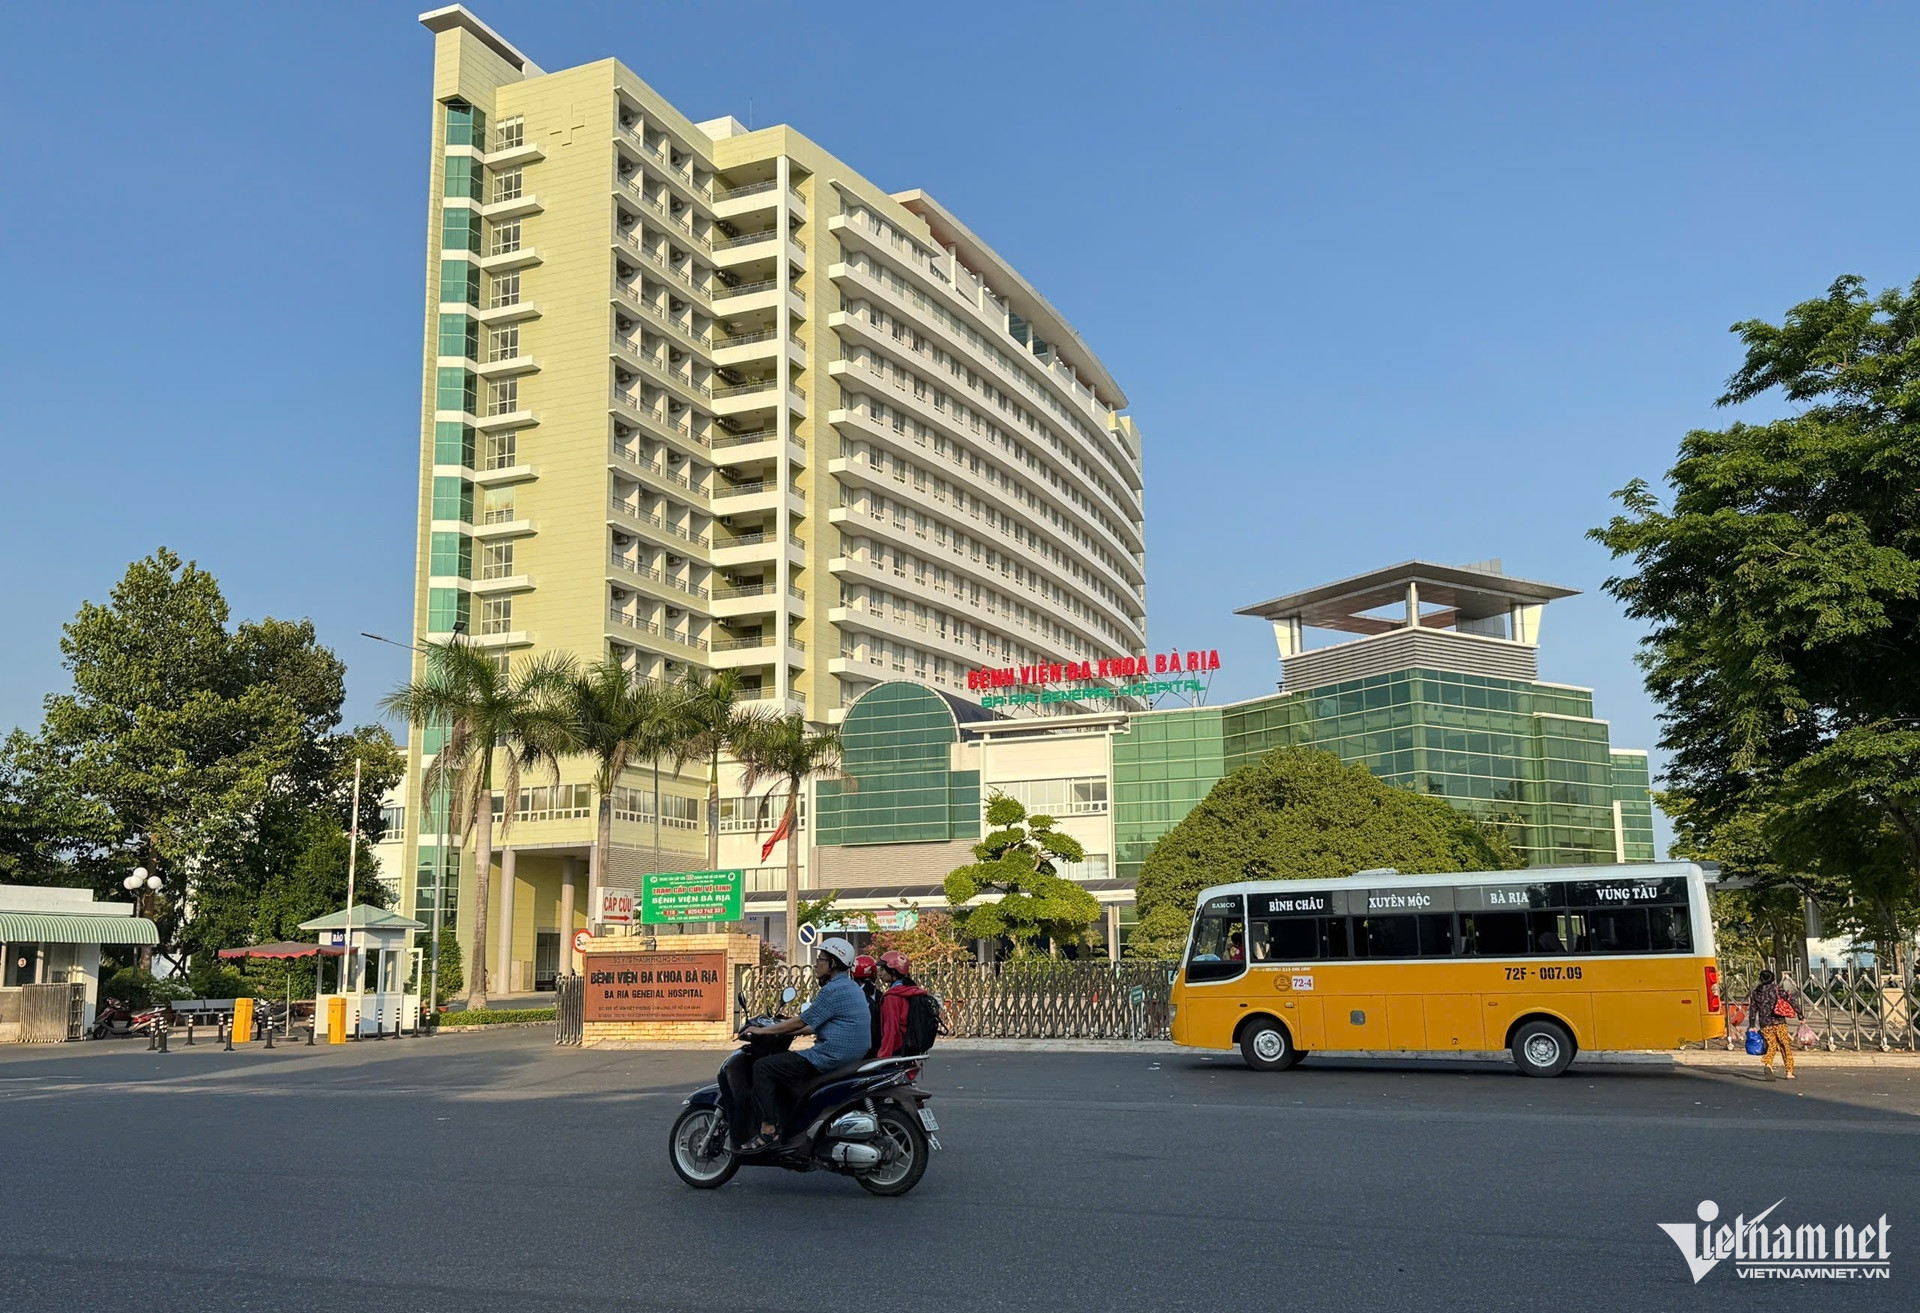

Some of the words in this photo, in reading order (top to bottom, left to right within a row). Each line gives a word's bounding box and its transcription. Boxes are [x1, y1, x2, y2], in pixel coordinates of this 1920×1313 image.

[1020, 658, 1062, 688] VIỆN
[1066, 661, 1092, 681] ĐA
[1098, 655, 1150, 678] KHOA
[1156, 648, 1182, 673] BÀ
[1186, 650, 1220, 674] RỊA
[1040, 687, 1115, 704] GENERAL
[1120, 679, 1206, 696] HOSPITAL
[652, 896, 676, 904] BỆNH
[678, 895, 698, 904] VIỆN
[1490, 890, 1506, 904] BÀ
[1508, 892, 1529, 905] RỊA
[1596, 885, 1630, 900] VŨNG
[1632, 884, 1658, 899] TÀU
[604, 891, 618, 912] CẤP
[619, 894, 632, 912] CỨU
[1269, 898, 1294, 912] BÌNH
[1295, 896, 1324, 910] CHÂU
[1369, 894, 1405, 908] XUYÊN
[1408, 893, 1430, 909] MỘC
[591, 970, 614, 986] BỆNH
[618, 969, 638, 986] VIỆN
[641, 971, 653, 983] ĐA
[657, 970, 682, 983] KHOA
[686, 968, 698, 982] BÀ
[701, 970, 718, 984] RỊA
[1505, 967, 1526, 980] 72F
[1540, 967, 1582, 980] 007.09
[1293, 978, 1312, 987] 72-4
[604, 990, 614, 998] BA
[617, 990, 629, 998] RIA
[632, 989, 664, 998] GENERAL
[668, 989, 704, 998] HOSPITAL
